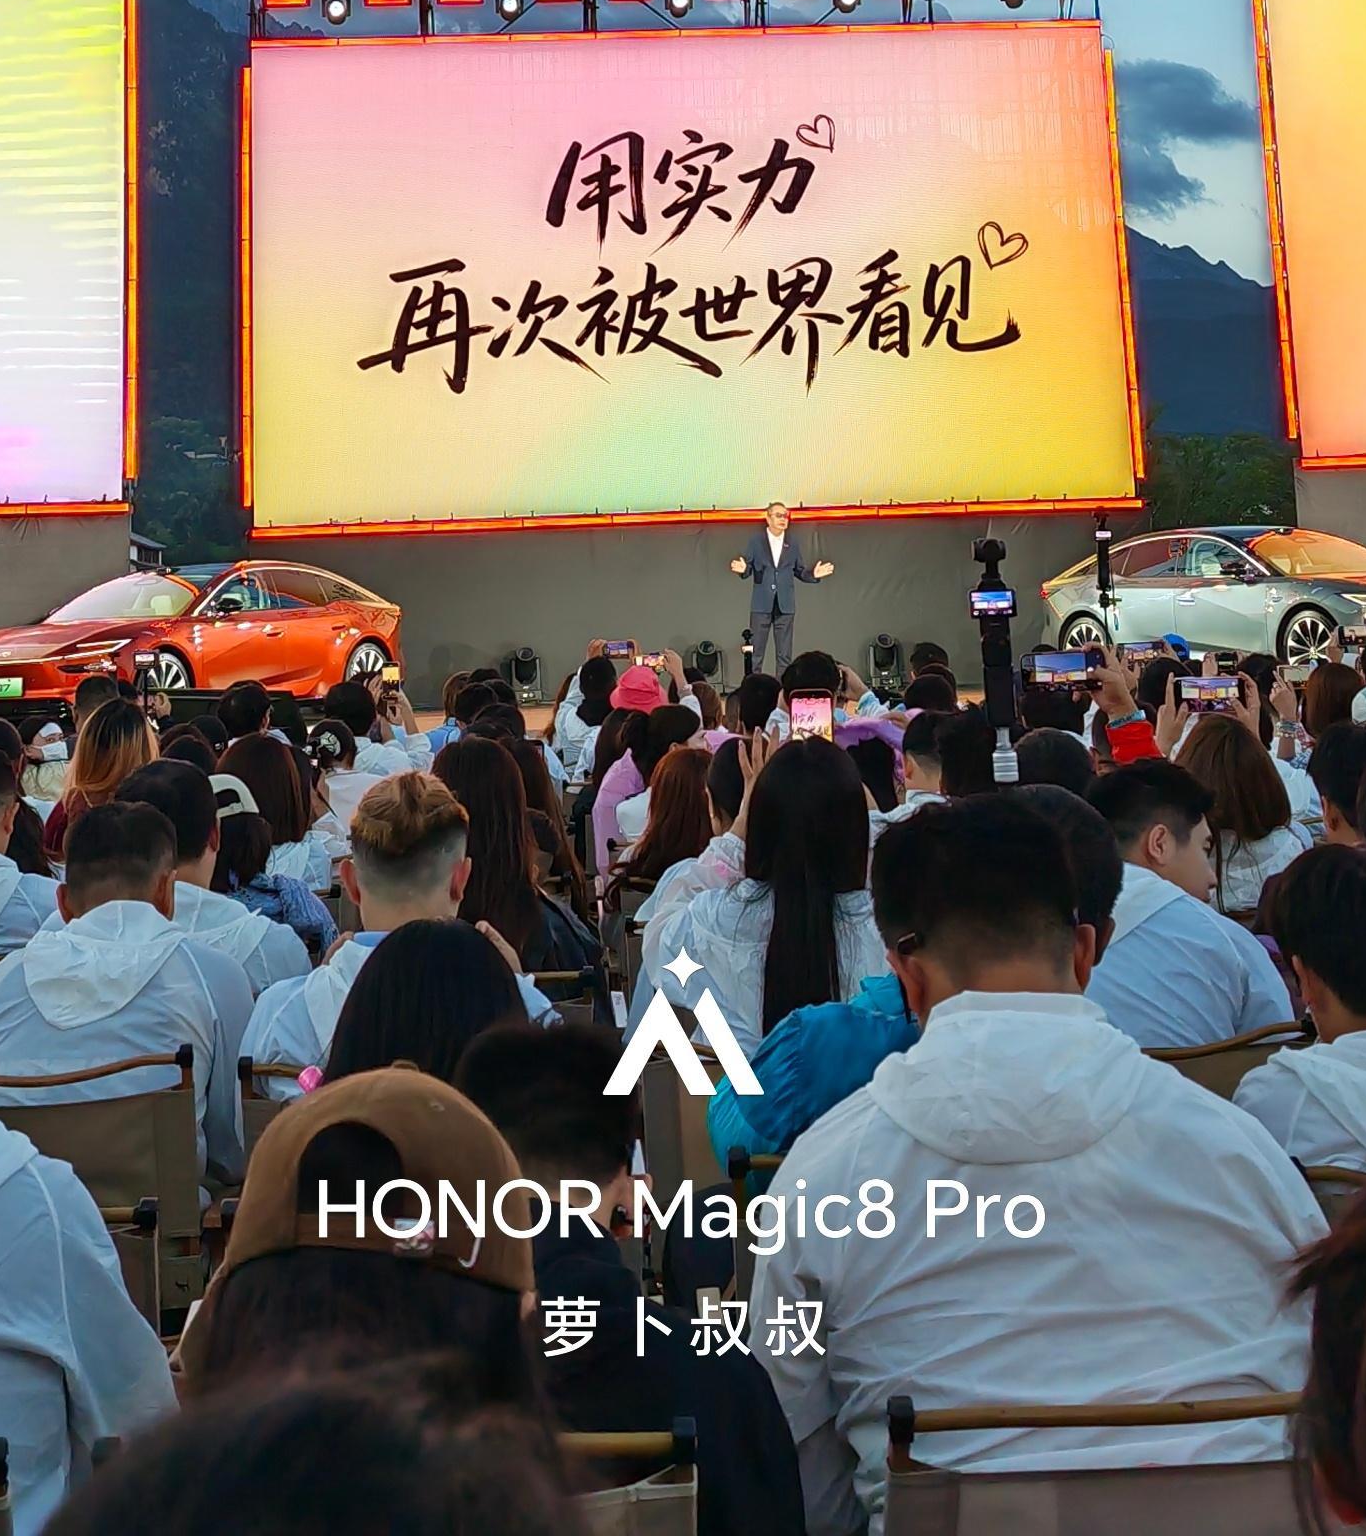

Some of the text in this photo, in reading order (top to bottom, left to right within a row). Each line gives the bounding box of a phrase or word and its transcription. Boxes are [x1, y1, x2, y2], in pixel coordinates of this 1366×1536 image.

[545, 128, 816, 252] 用实力
[356, 248, 1022, 394] 再次被世界看见
